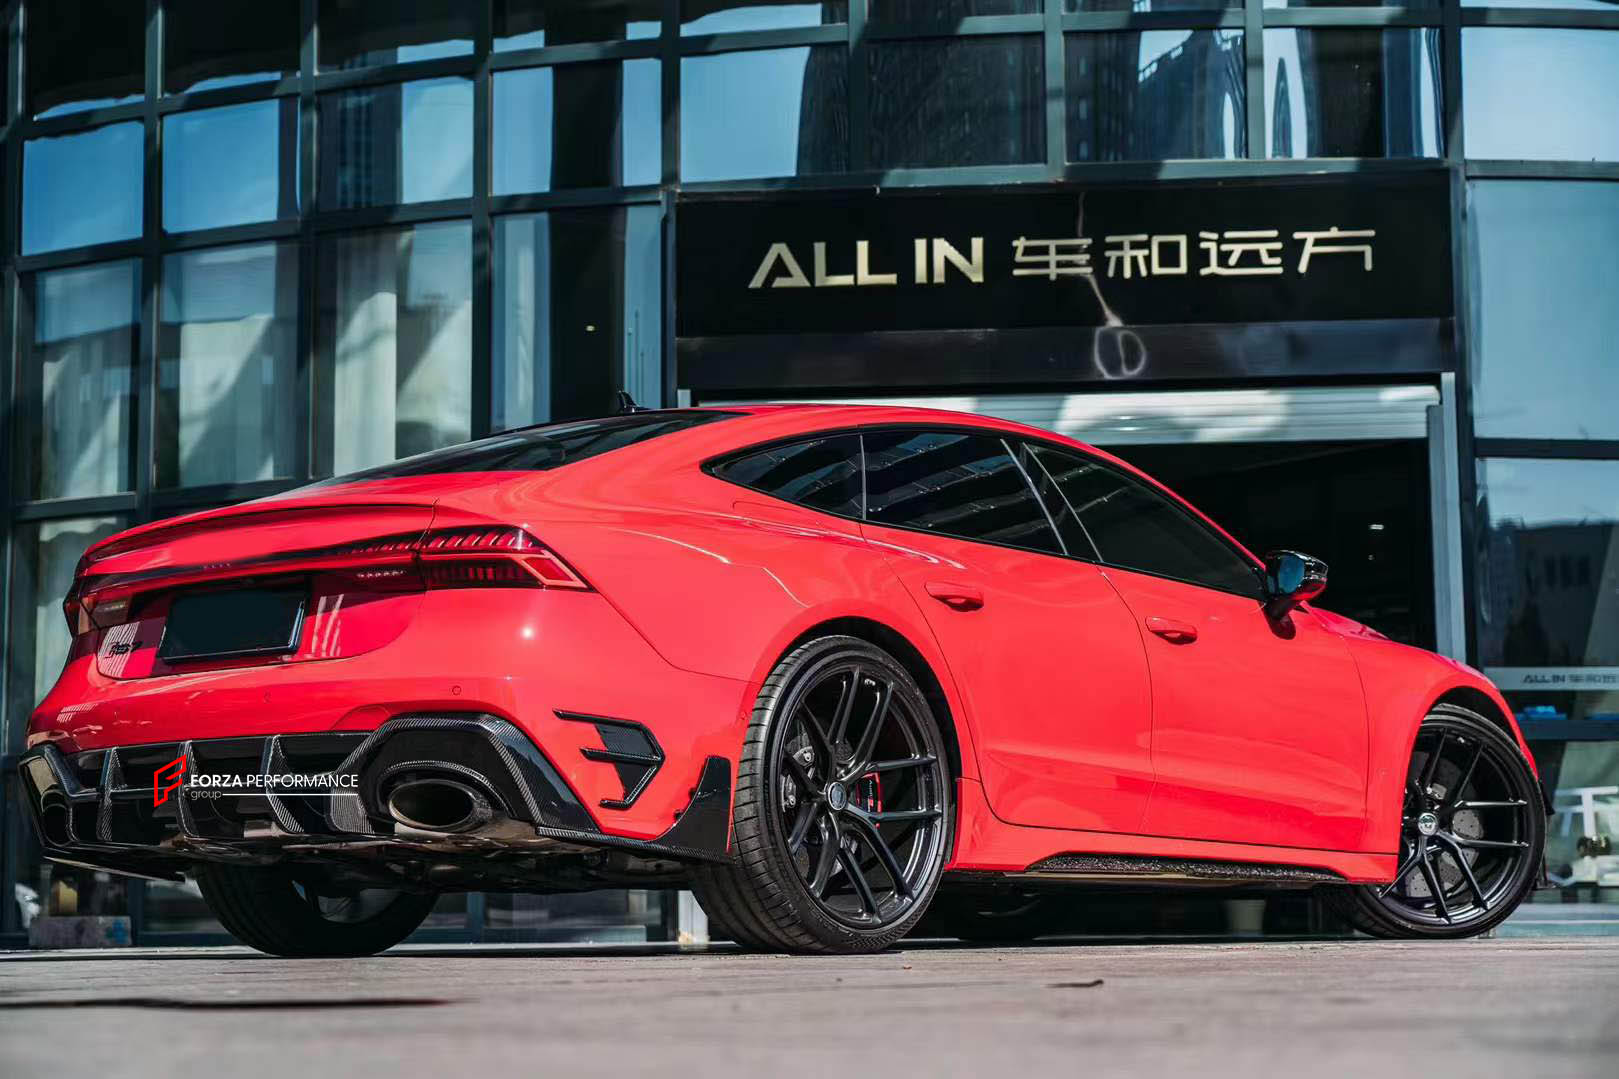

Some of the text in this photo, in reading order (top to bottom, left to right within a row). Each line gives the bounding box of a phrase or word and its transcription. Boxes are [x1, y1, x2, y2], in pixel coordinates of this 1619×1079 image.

[748, 226, 1376, 289] ALL IN 车和远方
